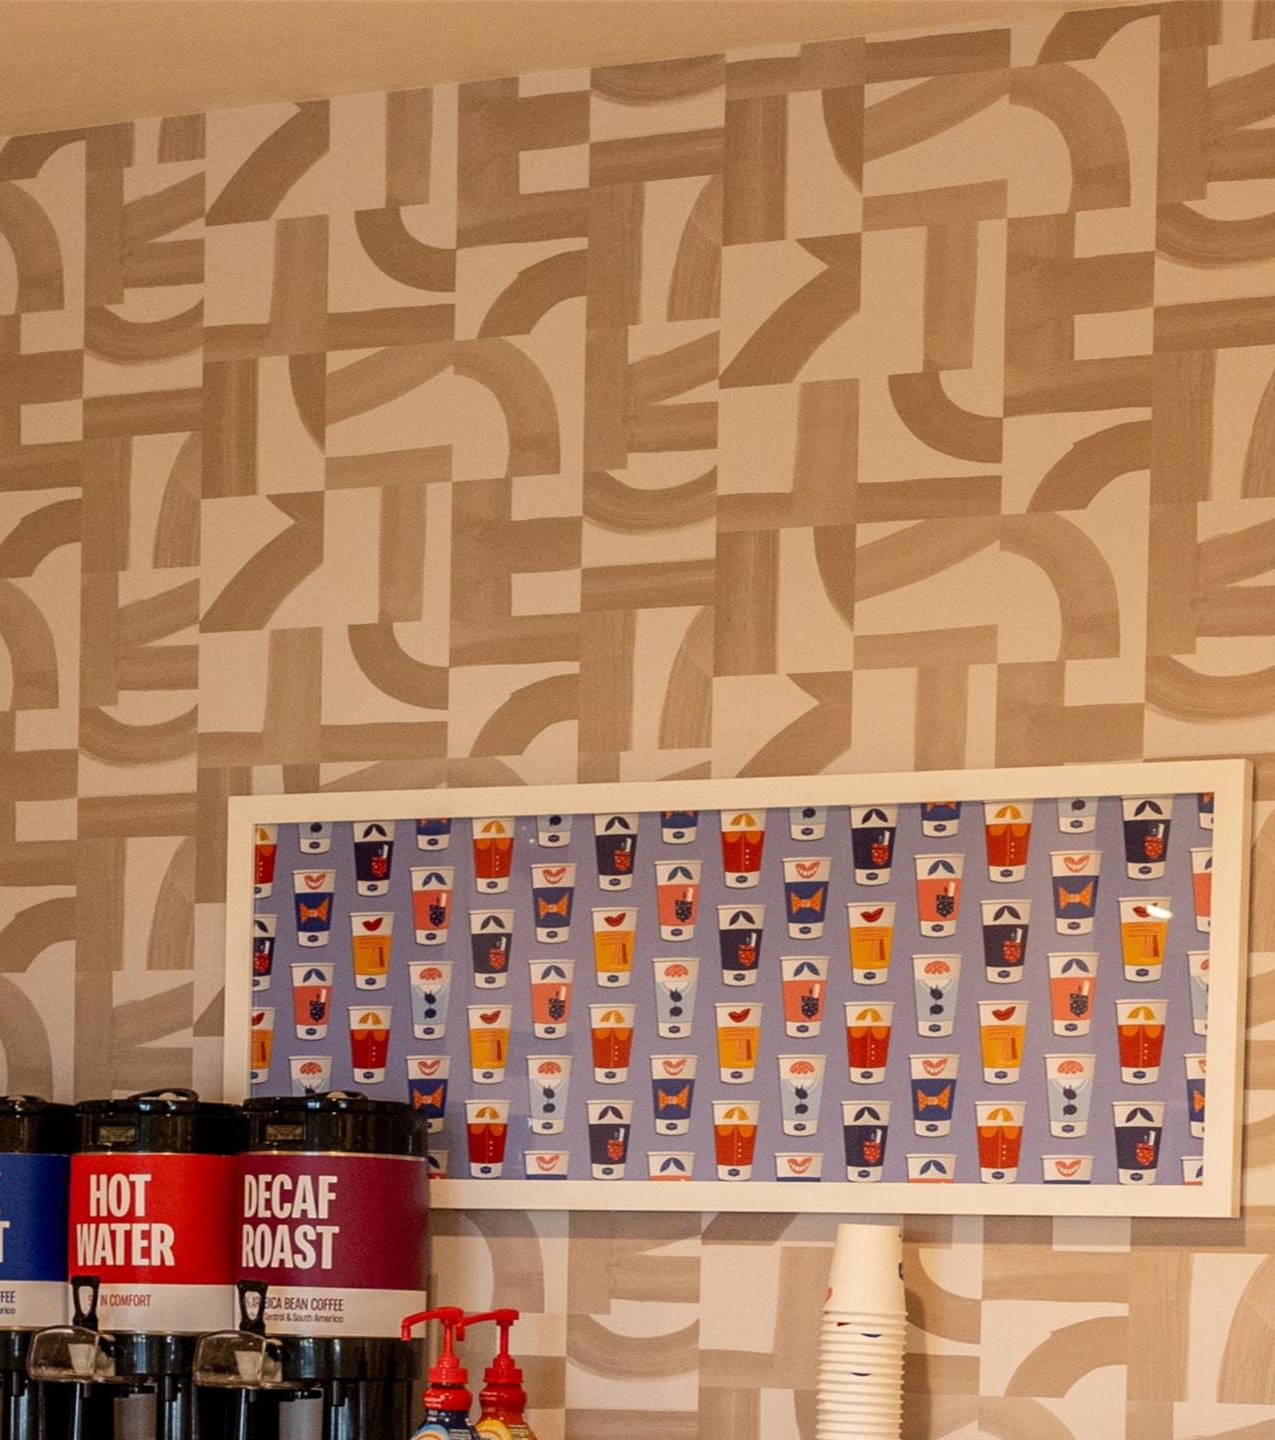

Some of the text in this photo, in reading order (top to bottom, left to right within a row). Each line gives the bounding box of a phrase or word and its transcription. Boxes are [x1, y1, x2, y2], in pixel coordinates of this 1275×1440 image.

[89, 1173, 152, 1218] HOT
[244, 1174, 338, 1219] DECAF
[76, 1223, 175, 1267] WATER
[241, 1223, 340, 1269] ROAST
[109, 1294, 151, 1307] COMFORT
[284, 1297, 308, 1310] BEAN
[310, 1298, 344, 1312] COFFEE
